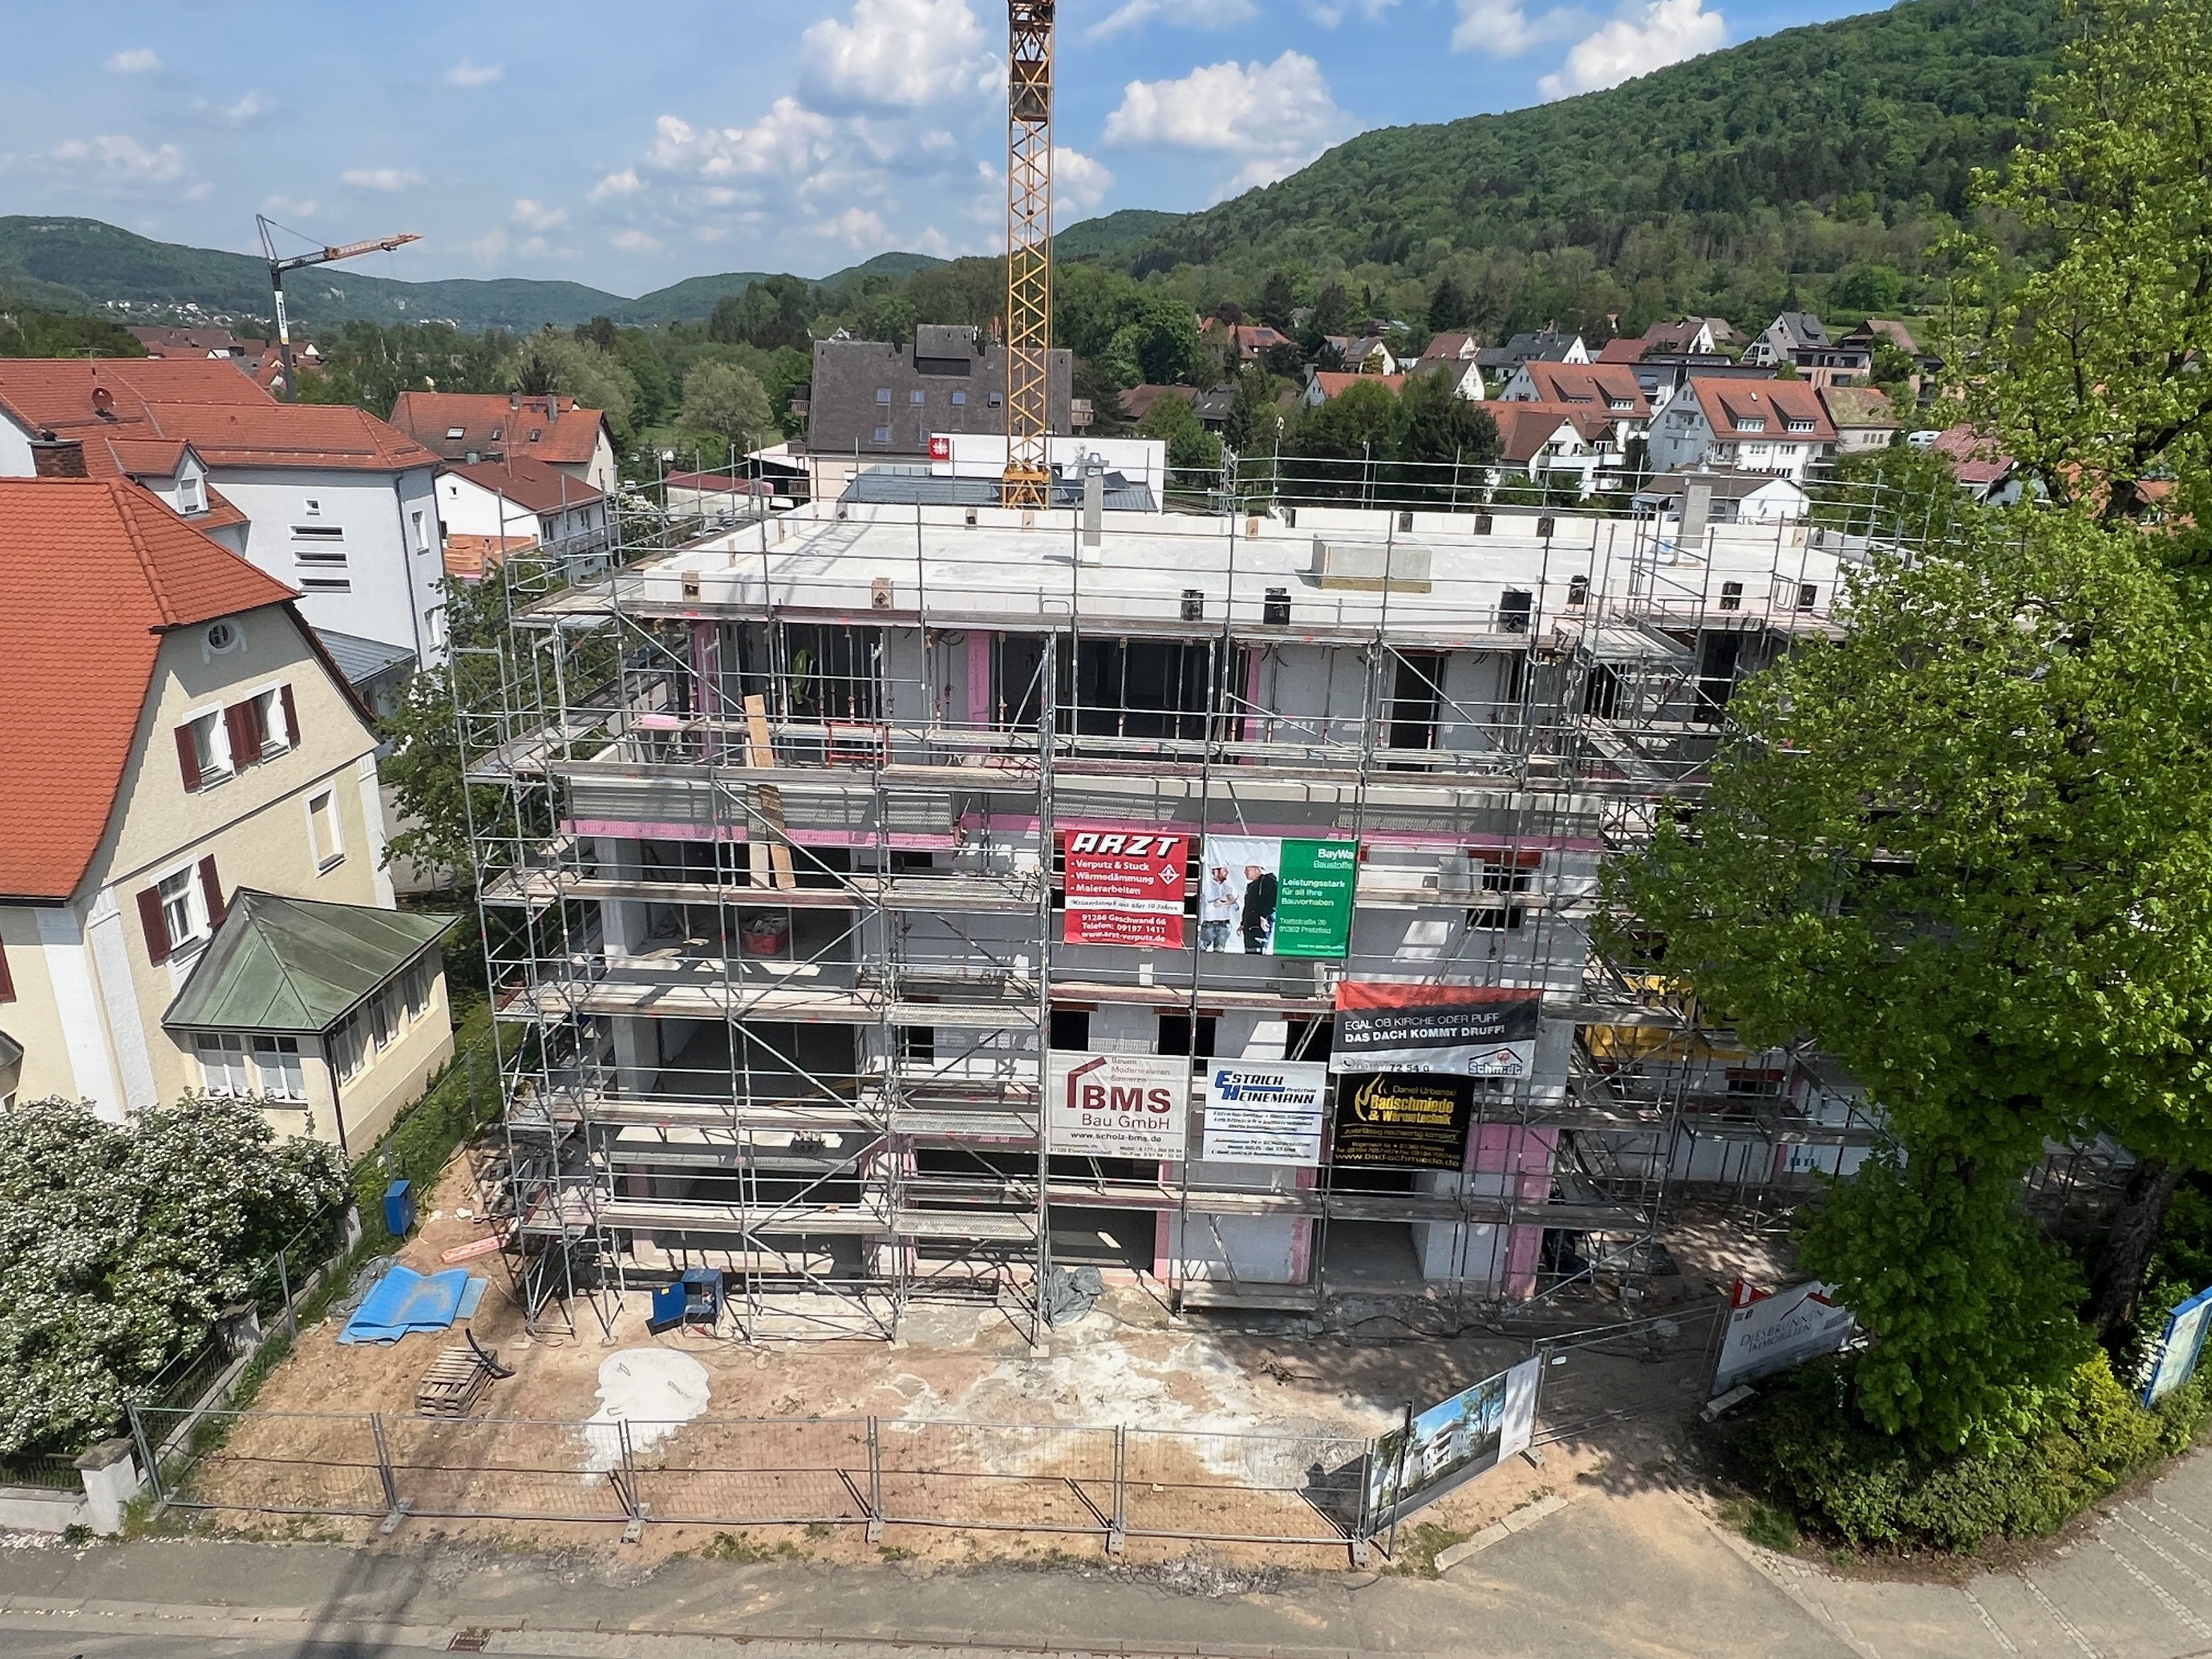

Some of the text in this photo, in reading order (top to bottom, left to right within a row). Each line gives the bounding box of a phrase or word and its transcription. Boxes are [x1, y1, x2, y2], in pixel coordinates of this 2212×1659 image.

[1071, 833, 1180, 857] ARZT
[1318, 848, 1354, 860] BayWa
[1076, 859, 1149, 871] Verputz & Stuck
[1313, 860, 1353, 869] Baustoffe
[1076, 872, 1154, 885] Wärmedämmung
[1283, 878, 1345, 888] Leistungsstark
[1076, 884, 1142, 895] Malerarbeiten
[1281, 898, 1334, 906] Bauvorhaben
[1108, 914, 1154, 925] Geschwand
[1081, 932, 1166, 943] www.arzt-verputz.de
[1345, 1013, 1499, 1030] EGAL OB KIRCHE ODER PUFF
[1345, 1025, 1505, 1043] DAS DACH KOMMT DRUFF!
[1468, 1061, 1523, 1075] Schmidt
[1215, 1070, 1284, 1088] ESTRICH
[1082, 1084, 1171, 1114] BMS
[1221, 1084, 1315, 1104] HEINEMANN
[1370, 1094, 1454, 1114] Badschmiede
[1368, 1110, 1379, 1121] &
[1082, 1114, 1170, 1130] Bau GmbH
[1071, 1133, 1162, 1142] www.scholz-bms.de
